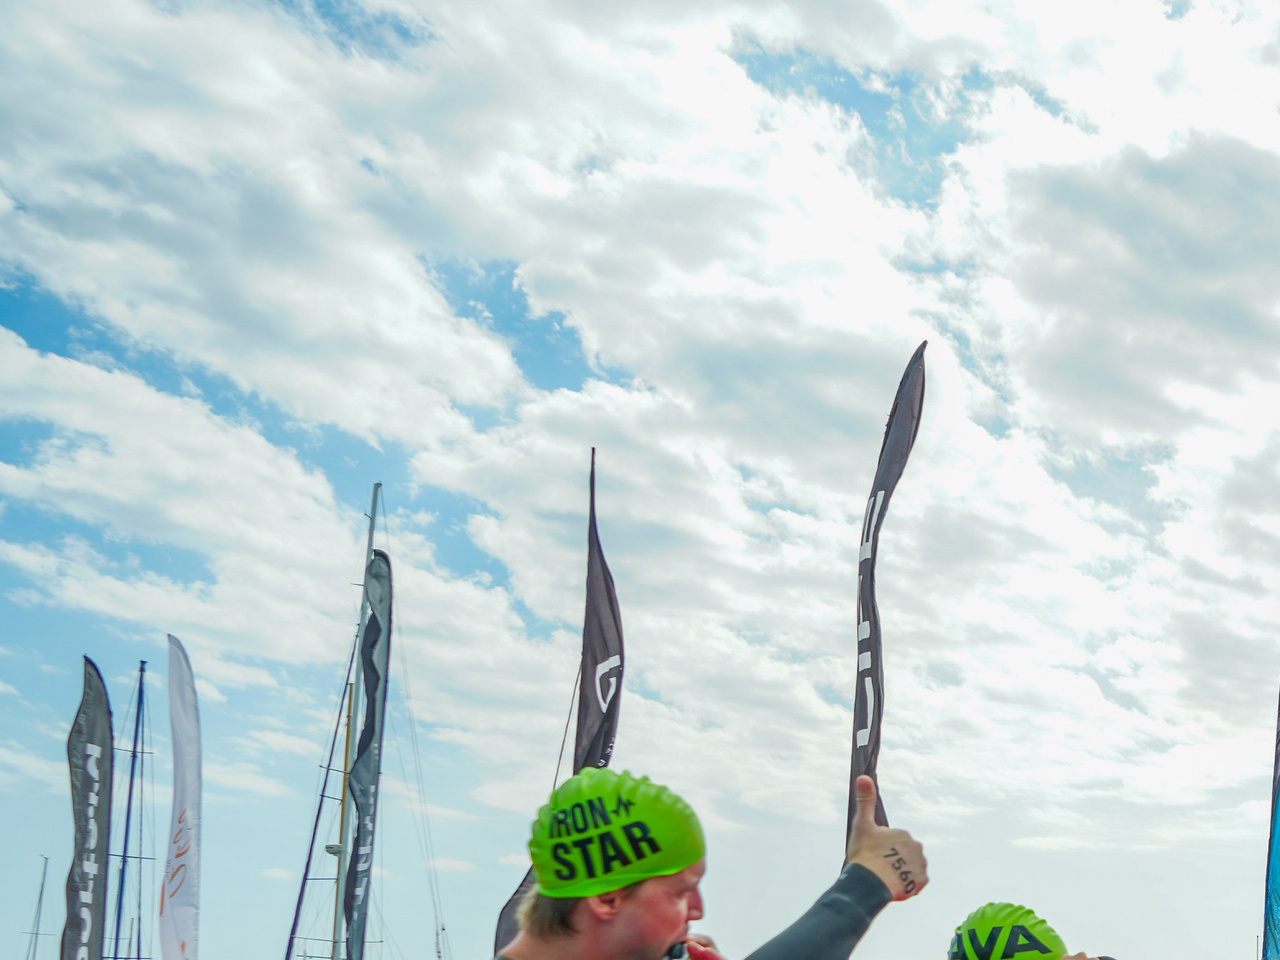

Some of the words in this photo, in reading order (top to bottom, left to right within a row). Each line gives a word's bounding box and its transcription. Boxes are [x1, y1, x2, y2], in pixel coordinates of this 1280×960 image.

[550, 797, 612, 838] IRON
[552, 821, 663, 881] STAR
[883, 848, 916, 894] 7560
